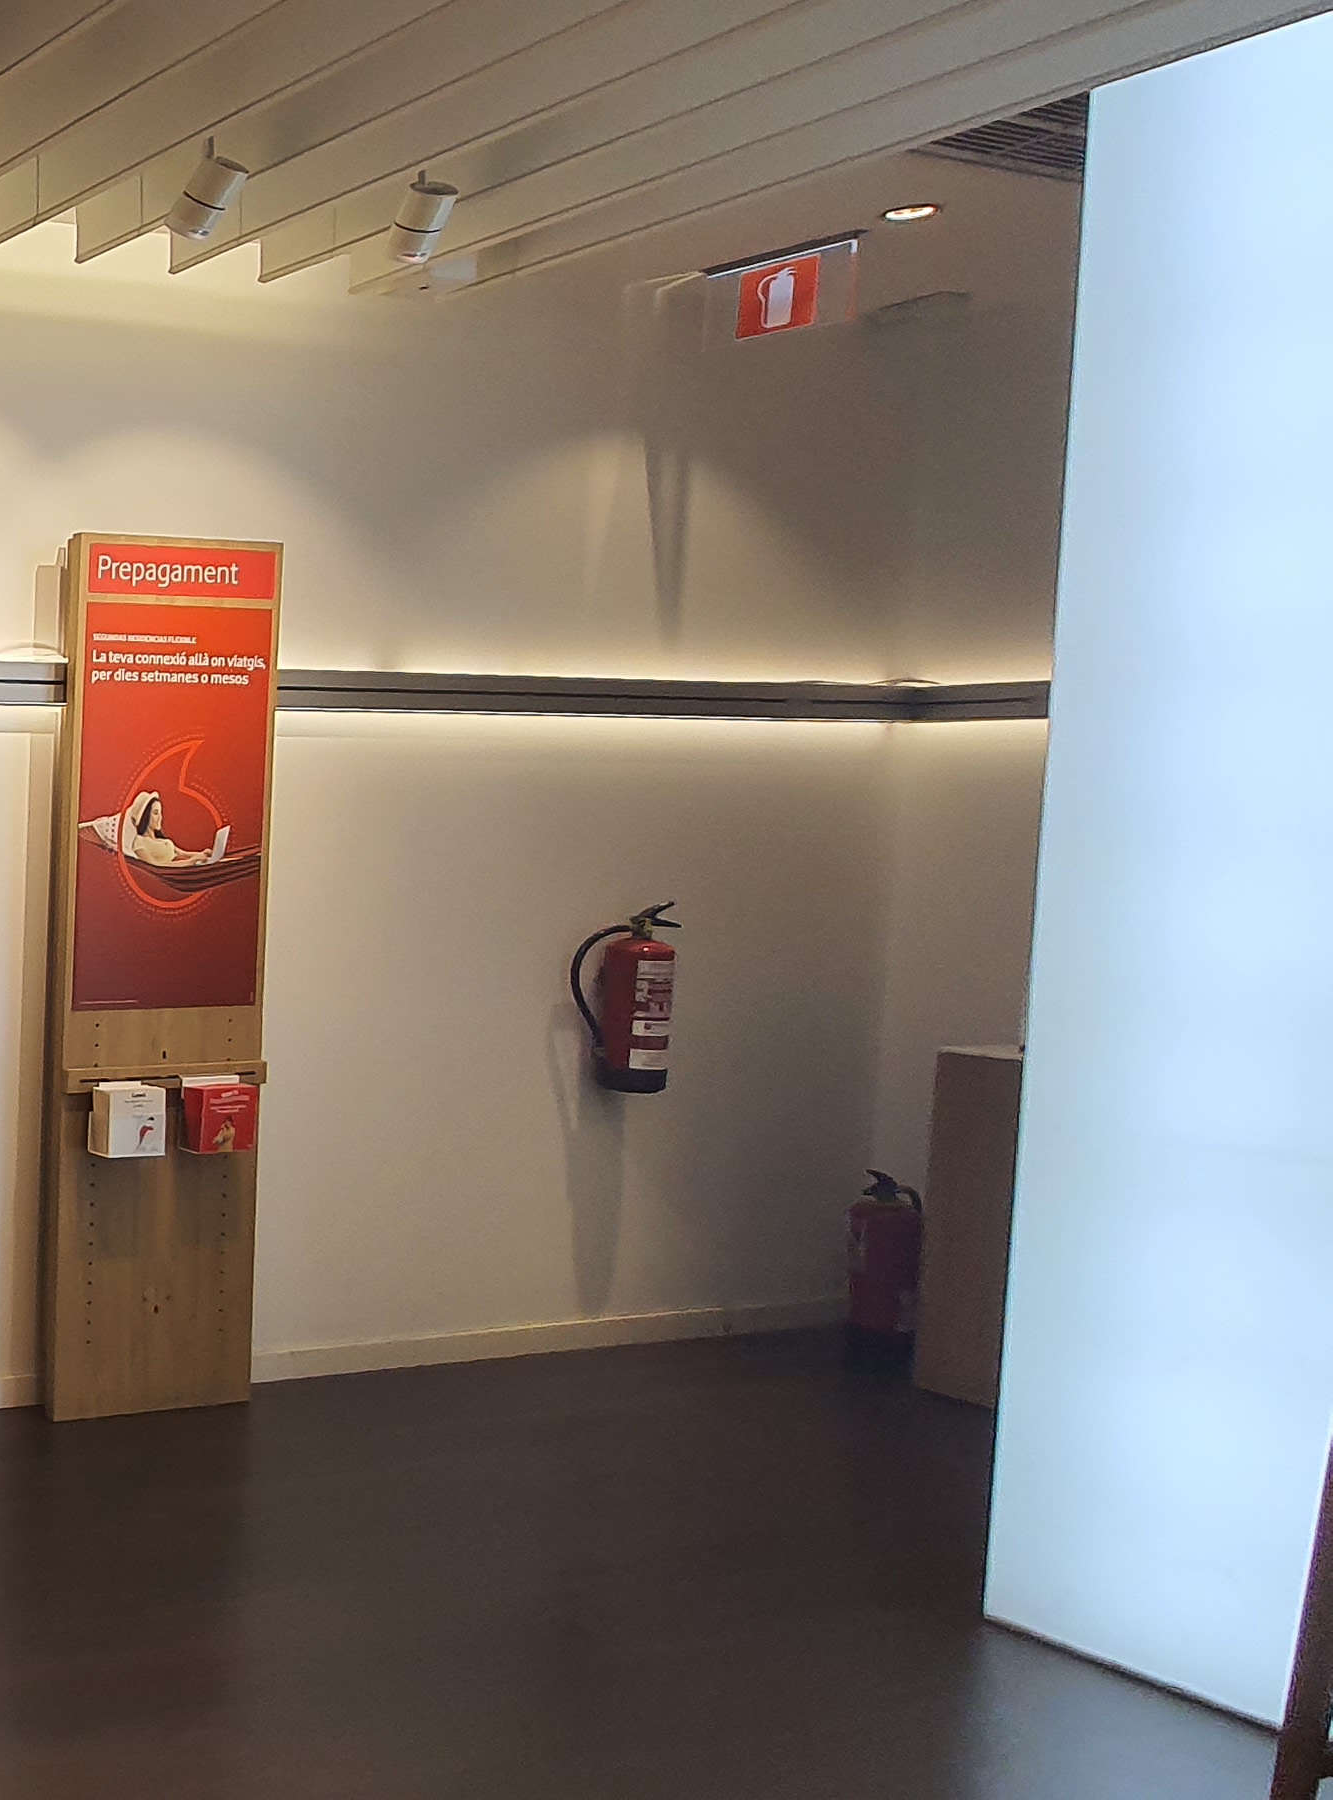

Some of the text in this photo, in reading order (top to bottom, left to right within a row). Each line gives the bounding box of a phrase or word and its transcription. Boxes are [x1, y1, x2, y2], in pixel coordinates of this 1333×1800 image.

[97, 555, 239, 587] Prepagament
[93, 650, 266, 671] La teva connexió allà on viatgis,
[92, 668, 249, 685] per dies setmanes o mesos
